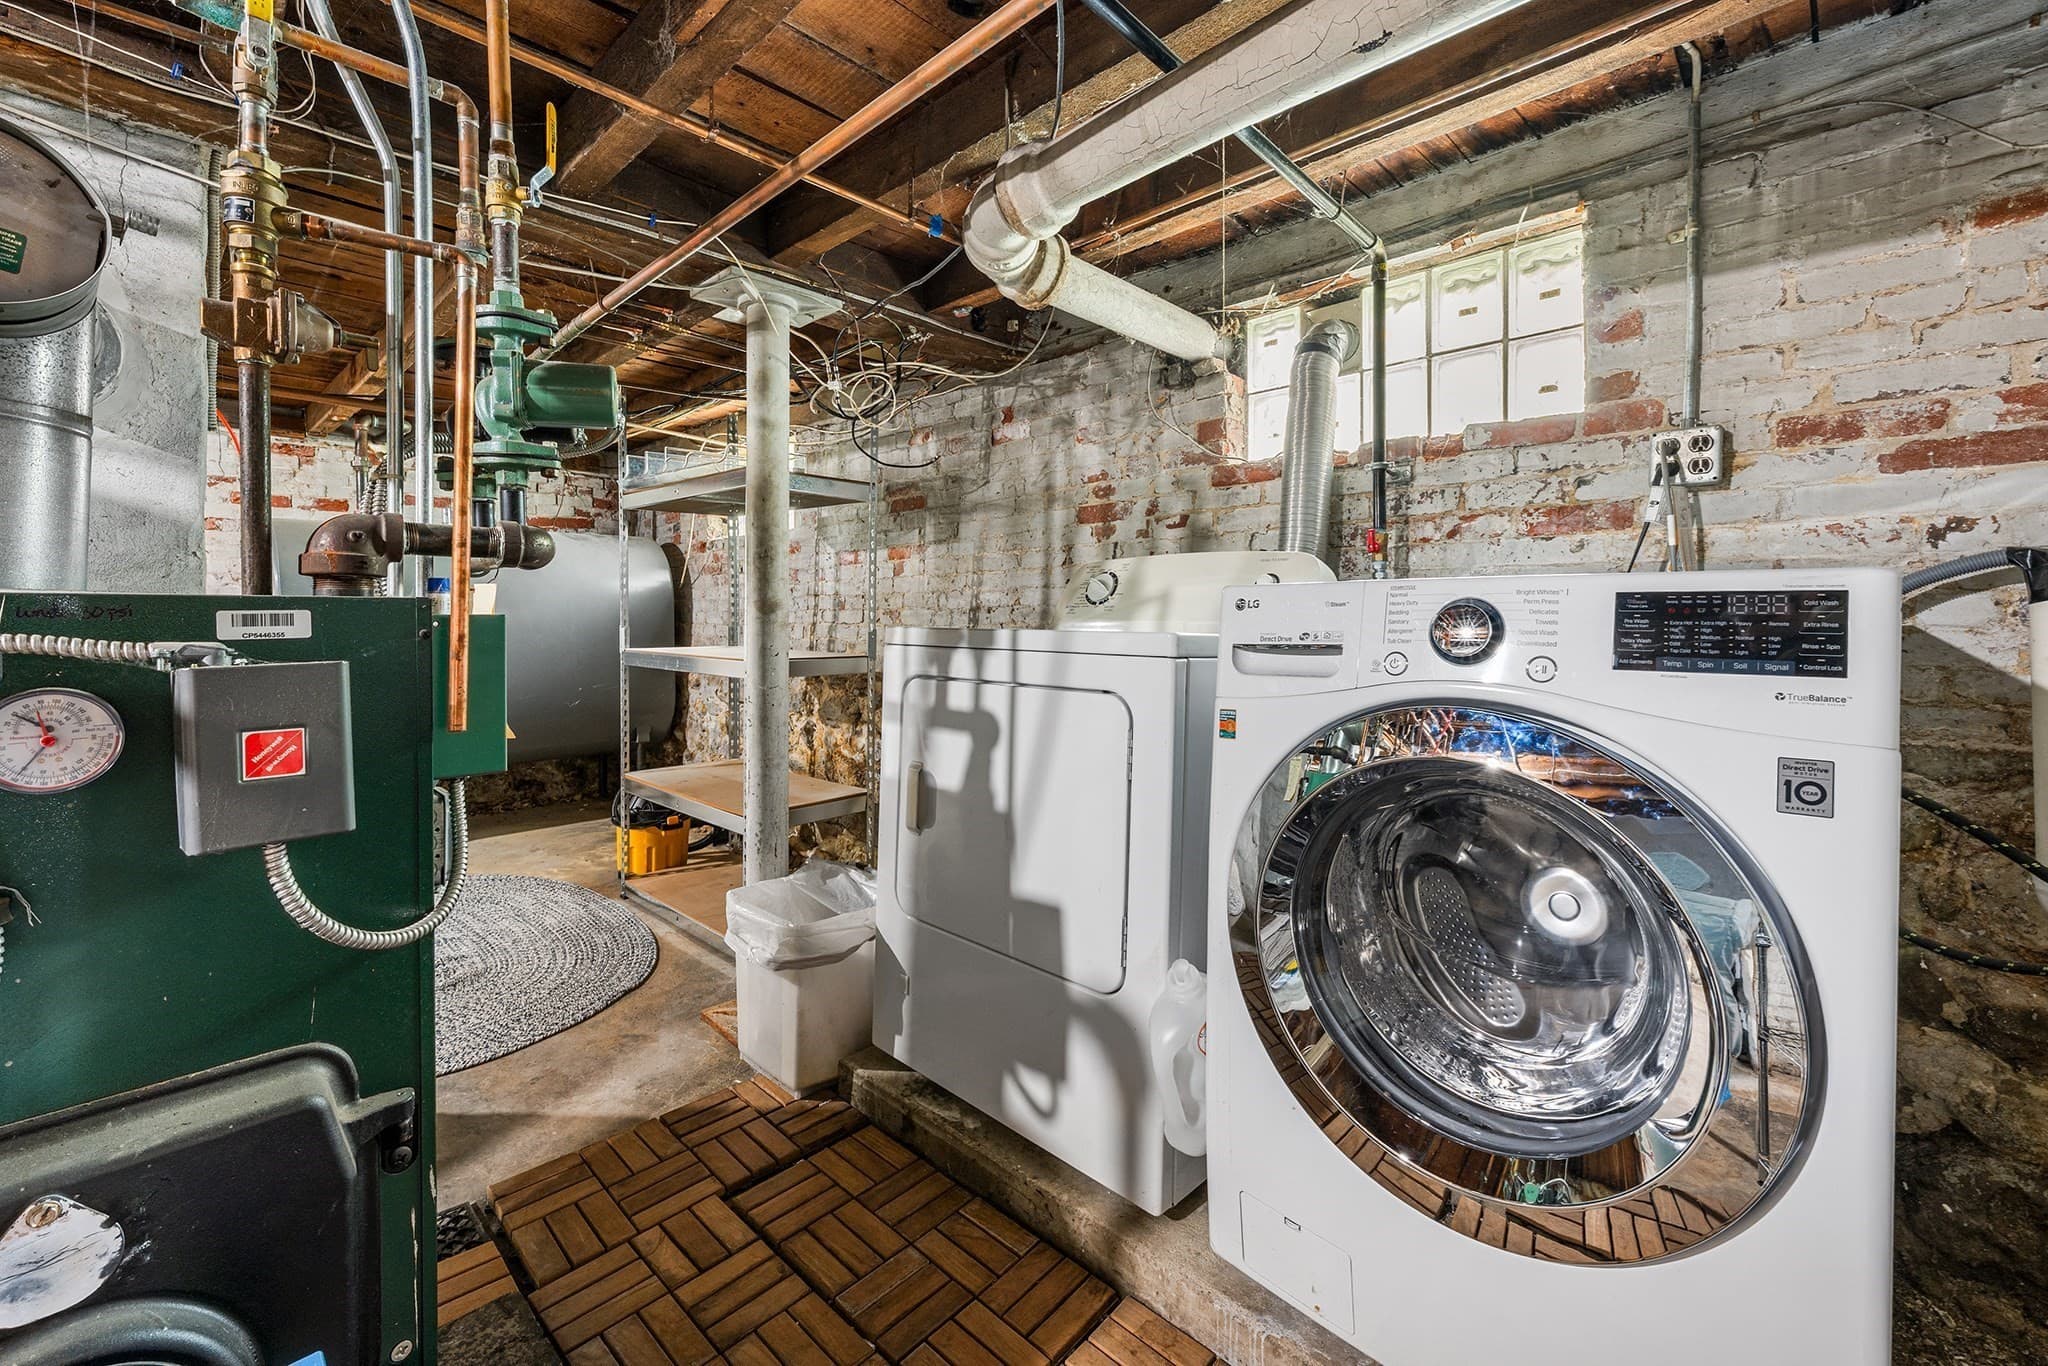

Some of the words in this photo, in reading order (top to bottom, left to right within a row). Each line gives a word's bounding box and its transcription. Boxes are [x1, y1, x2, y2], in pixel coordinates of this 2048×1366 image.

[1247, 599, 1260, 609] LG
[1697, 661, 1715, 670] Spin
[1733, 662, 1748, 670] Soil
[1764, 663, 1789, 673] Signal
[250, 734, 284, 764] Honeywell
[1782, 763, 1807, 772] Direct
[1807, 766, 1830, 774] Drive
[1783, 778, 1828, 806] 10
[1785, 805, 1826, 813] WARRANTY
